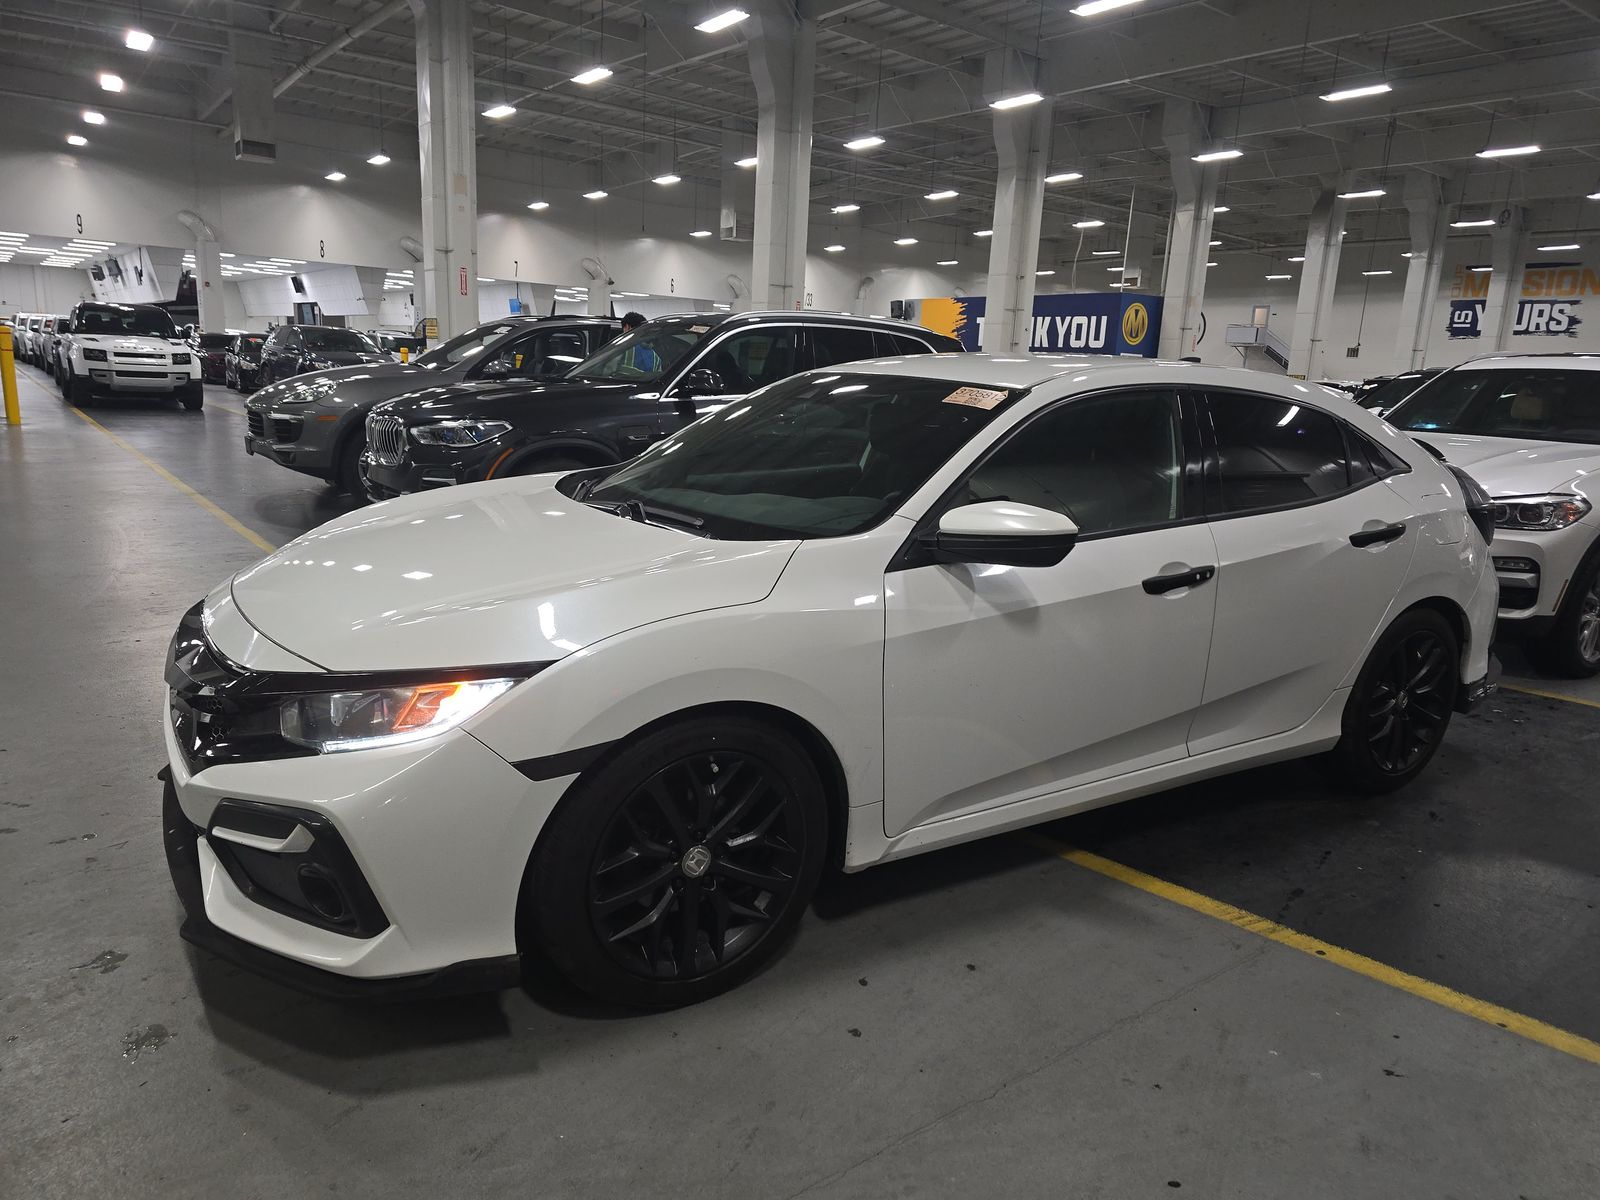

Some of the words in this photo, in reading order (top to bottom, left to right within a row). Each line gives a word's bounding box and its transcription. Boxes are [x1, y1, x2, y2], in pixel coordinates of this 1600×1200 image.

[76, 213, 83, 234] 9
[319, 239, 325, 258] 8
[670, 278, 675, 293] 6
[1462, 269, 1600, 297] MSION
[1453, 310, 1473, 328] IS
[1475, 303, 1571, 332] YURS
[1055, 315, 1108, 349] YOU
